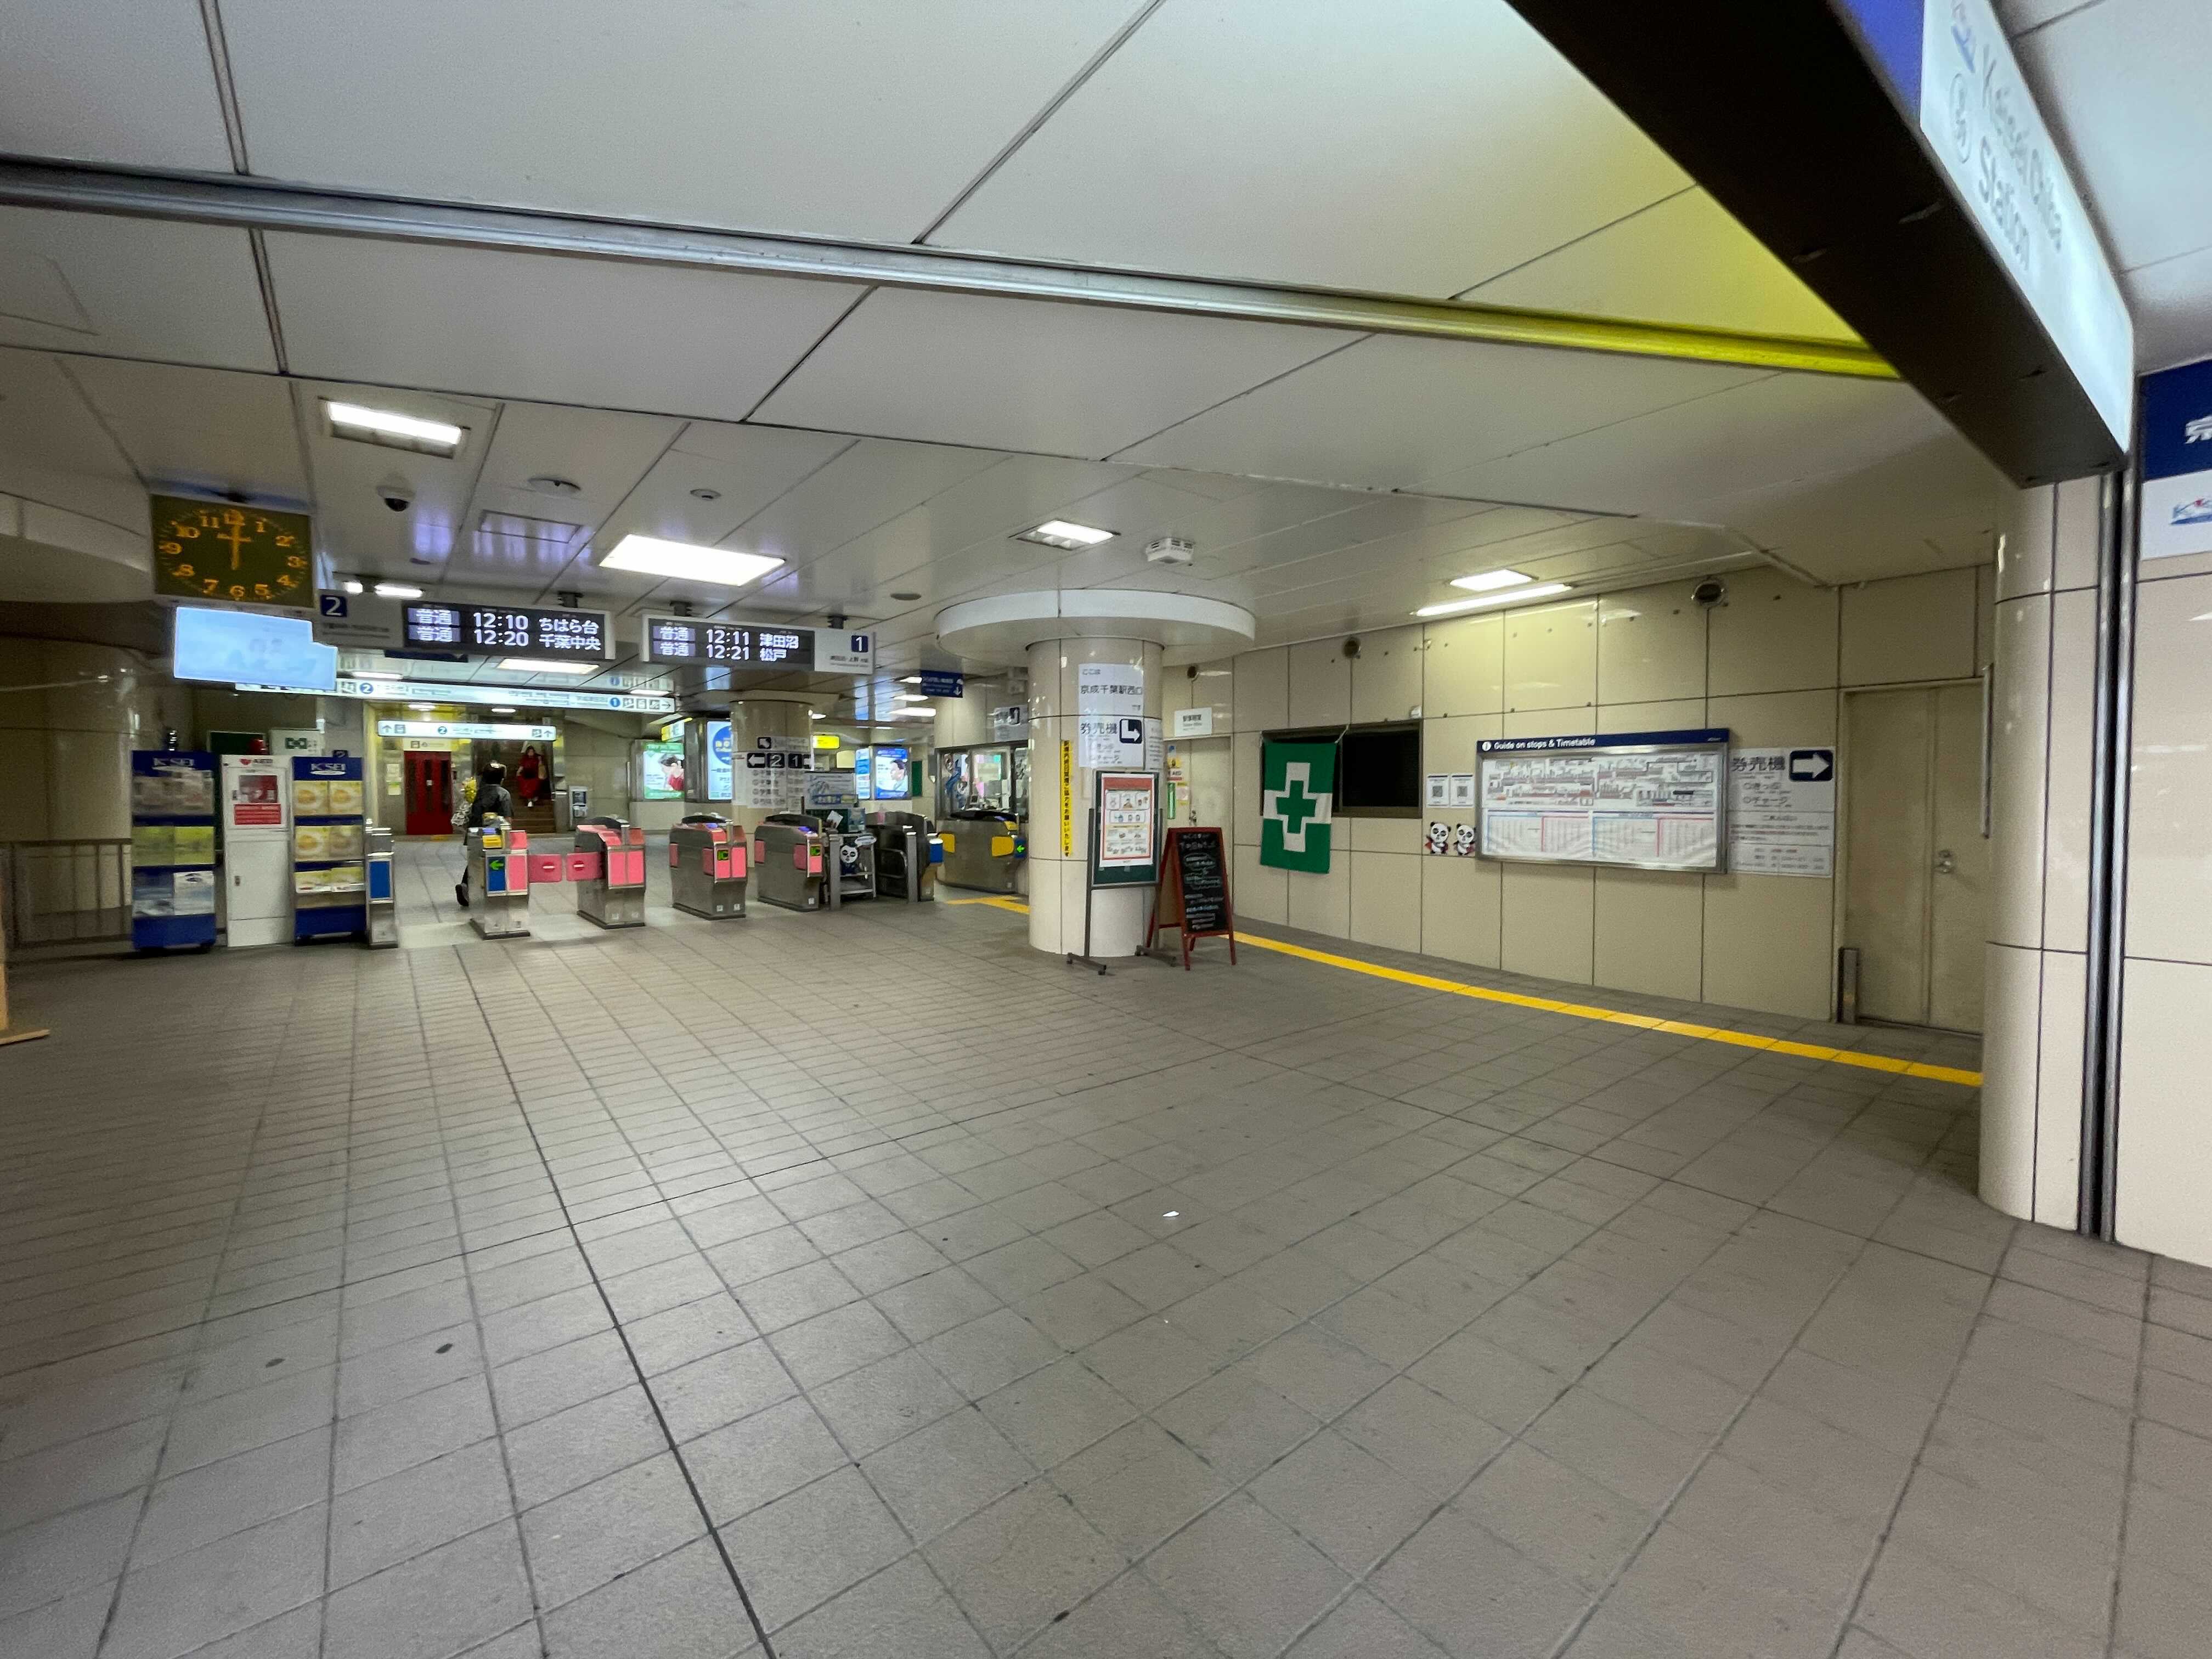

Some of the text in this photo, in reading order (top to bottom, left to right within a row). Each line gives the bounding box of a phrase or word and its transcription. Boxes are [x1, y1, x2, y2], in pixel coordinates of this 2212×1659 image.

[203, 579, 219, 593] 7
[229, 584, 245, 597] 6
[325, 596, 342, 616] 2
[416, 608, 599, 635] 普通 12:10 ちはら台
[417, 626, 601, 651] 普通 12:20 千葉中央
[660, 627, 799, 649] 普通 12:11 津田沼
[856, 636, 862, 652] 1
[660, 642, 787, 662] 普通 12:21 松戸
[1080, 685, 1142, 695] 京成千葉駅西口
[1494, 742, 1514, 750] Guide
[1527, 741, 1547, 750] stops
[1556, 738, 1596, 747] Timetable
[771, 754, 782, 767] 2
